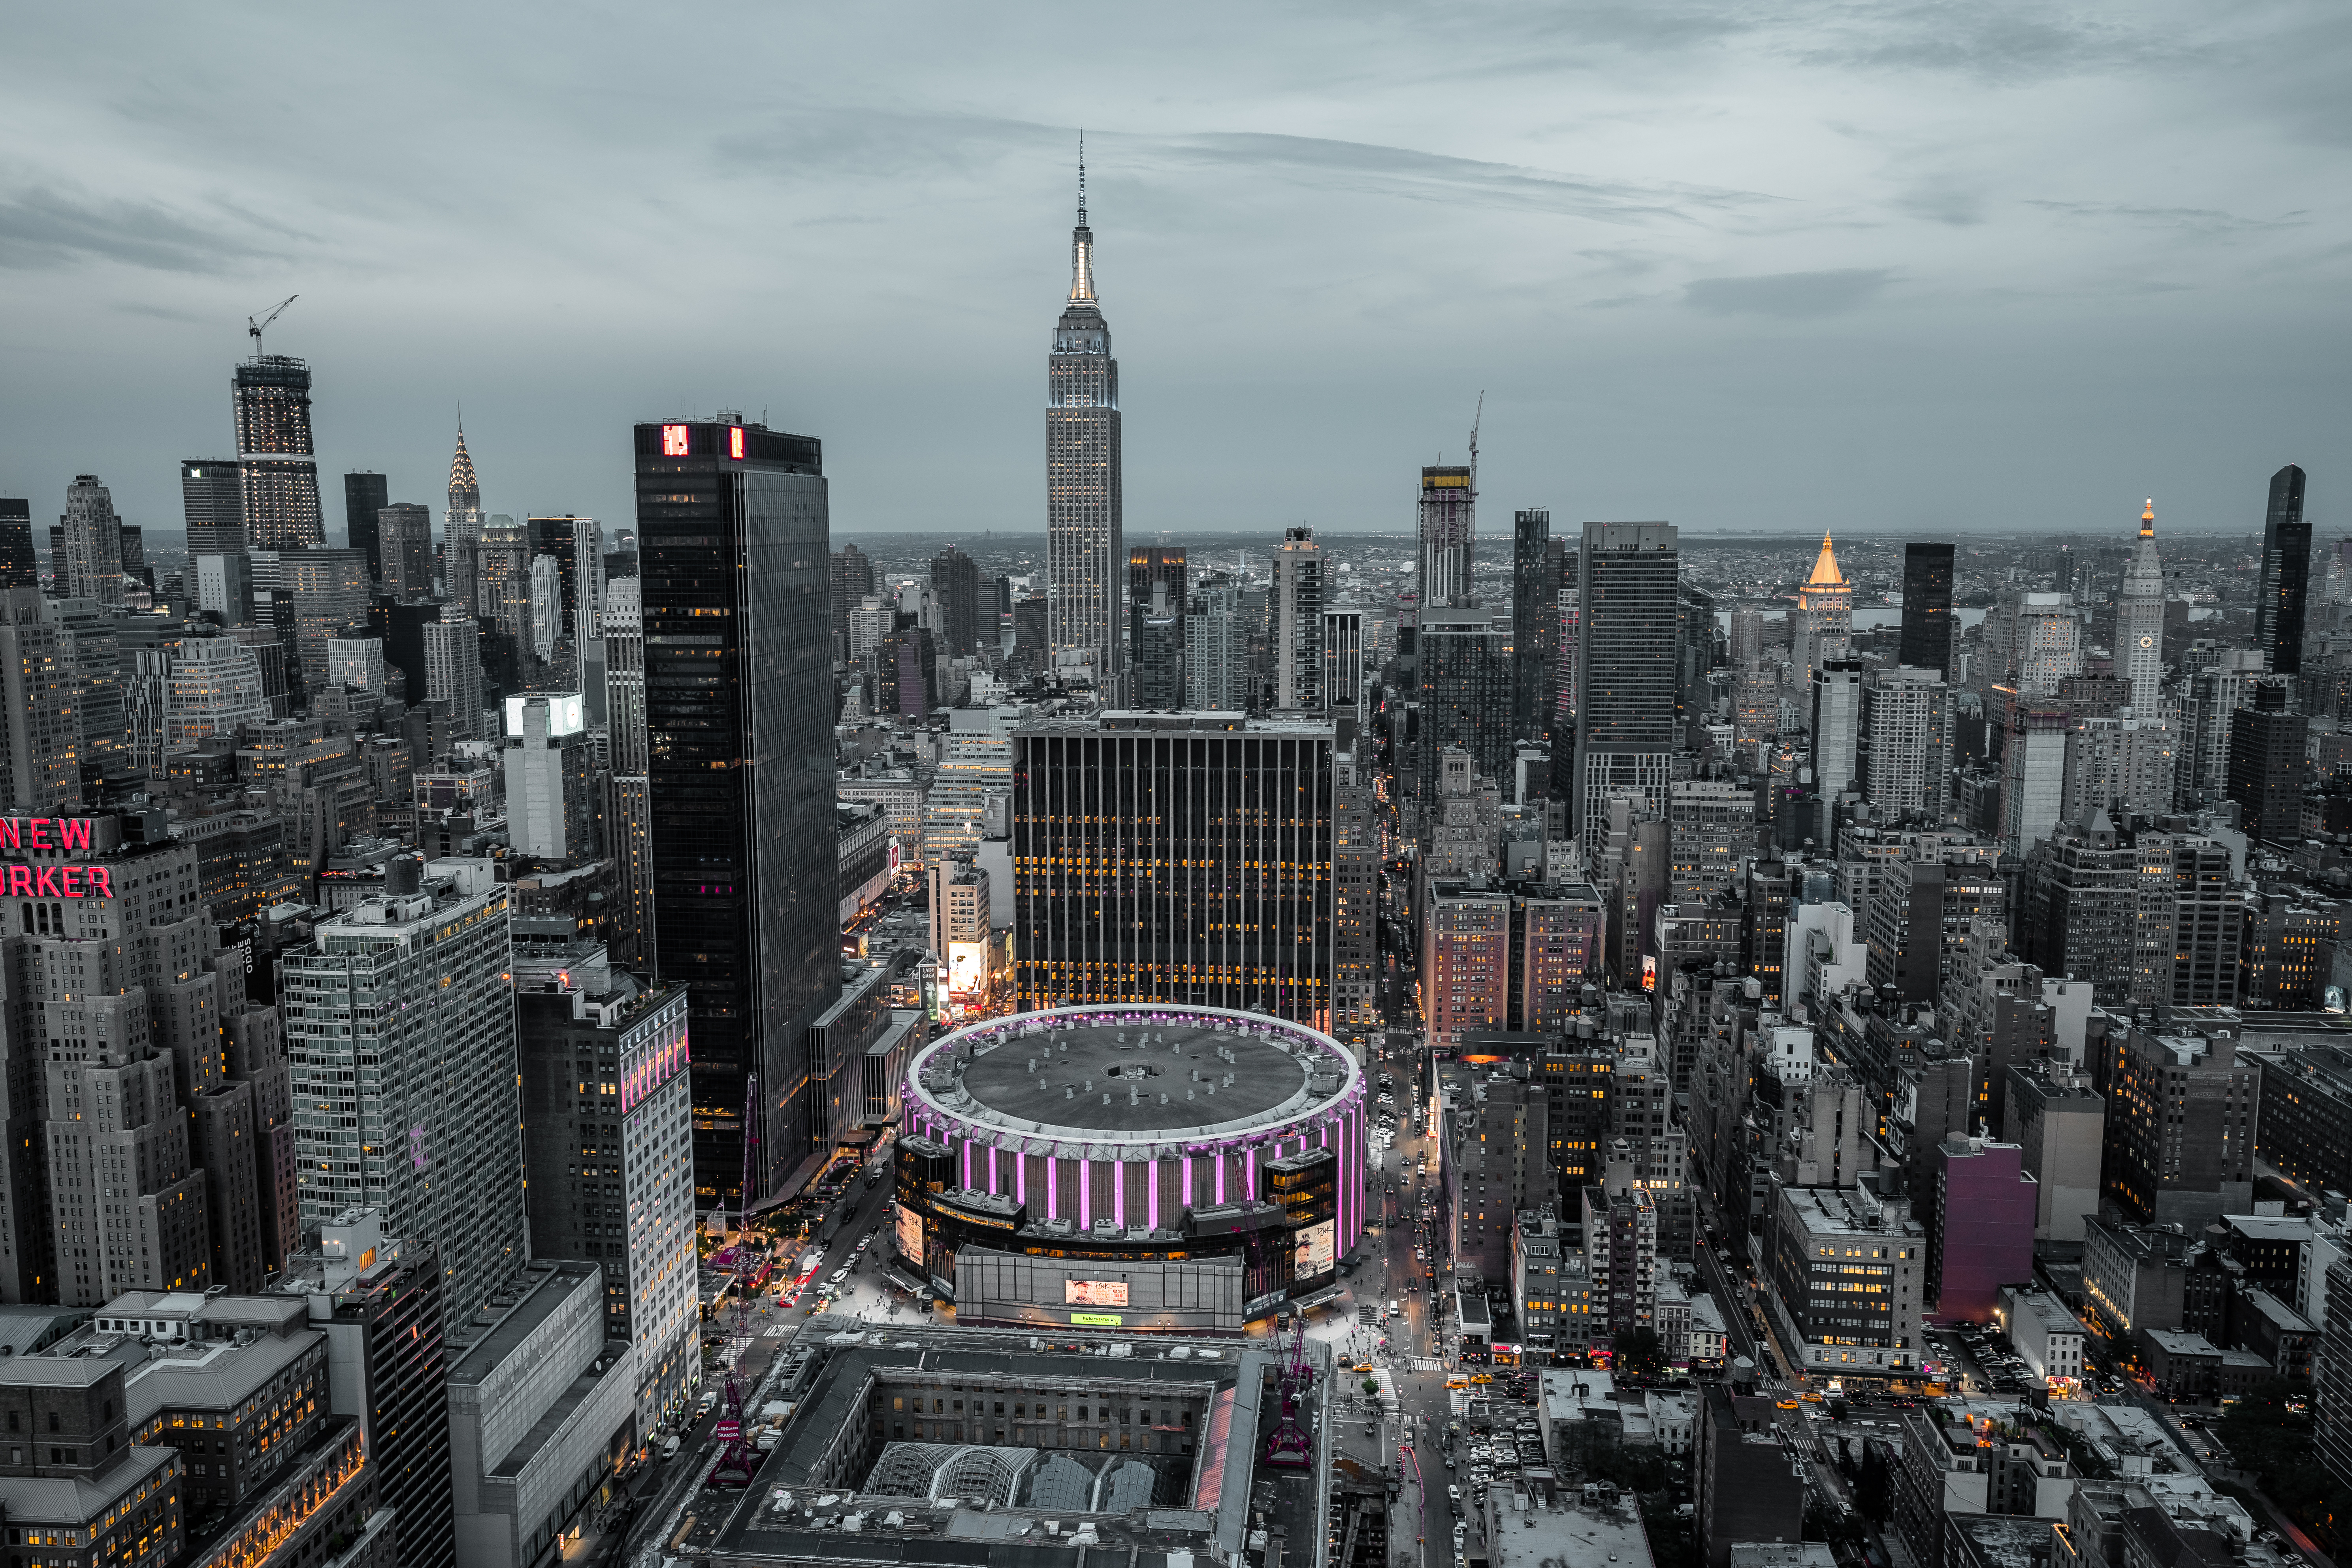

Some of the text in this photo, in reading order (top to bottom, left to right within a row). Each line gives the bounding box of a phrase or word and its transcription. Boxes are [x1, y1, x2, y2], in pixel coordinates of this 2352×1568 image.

[0, 818, 91, 849] NEW
[0, 866, 113, 898] RKER
[245, 938, 253, 973] ODDS
